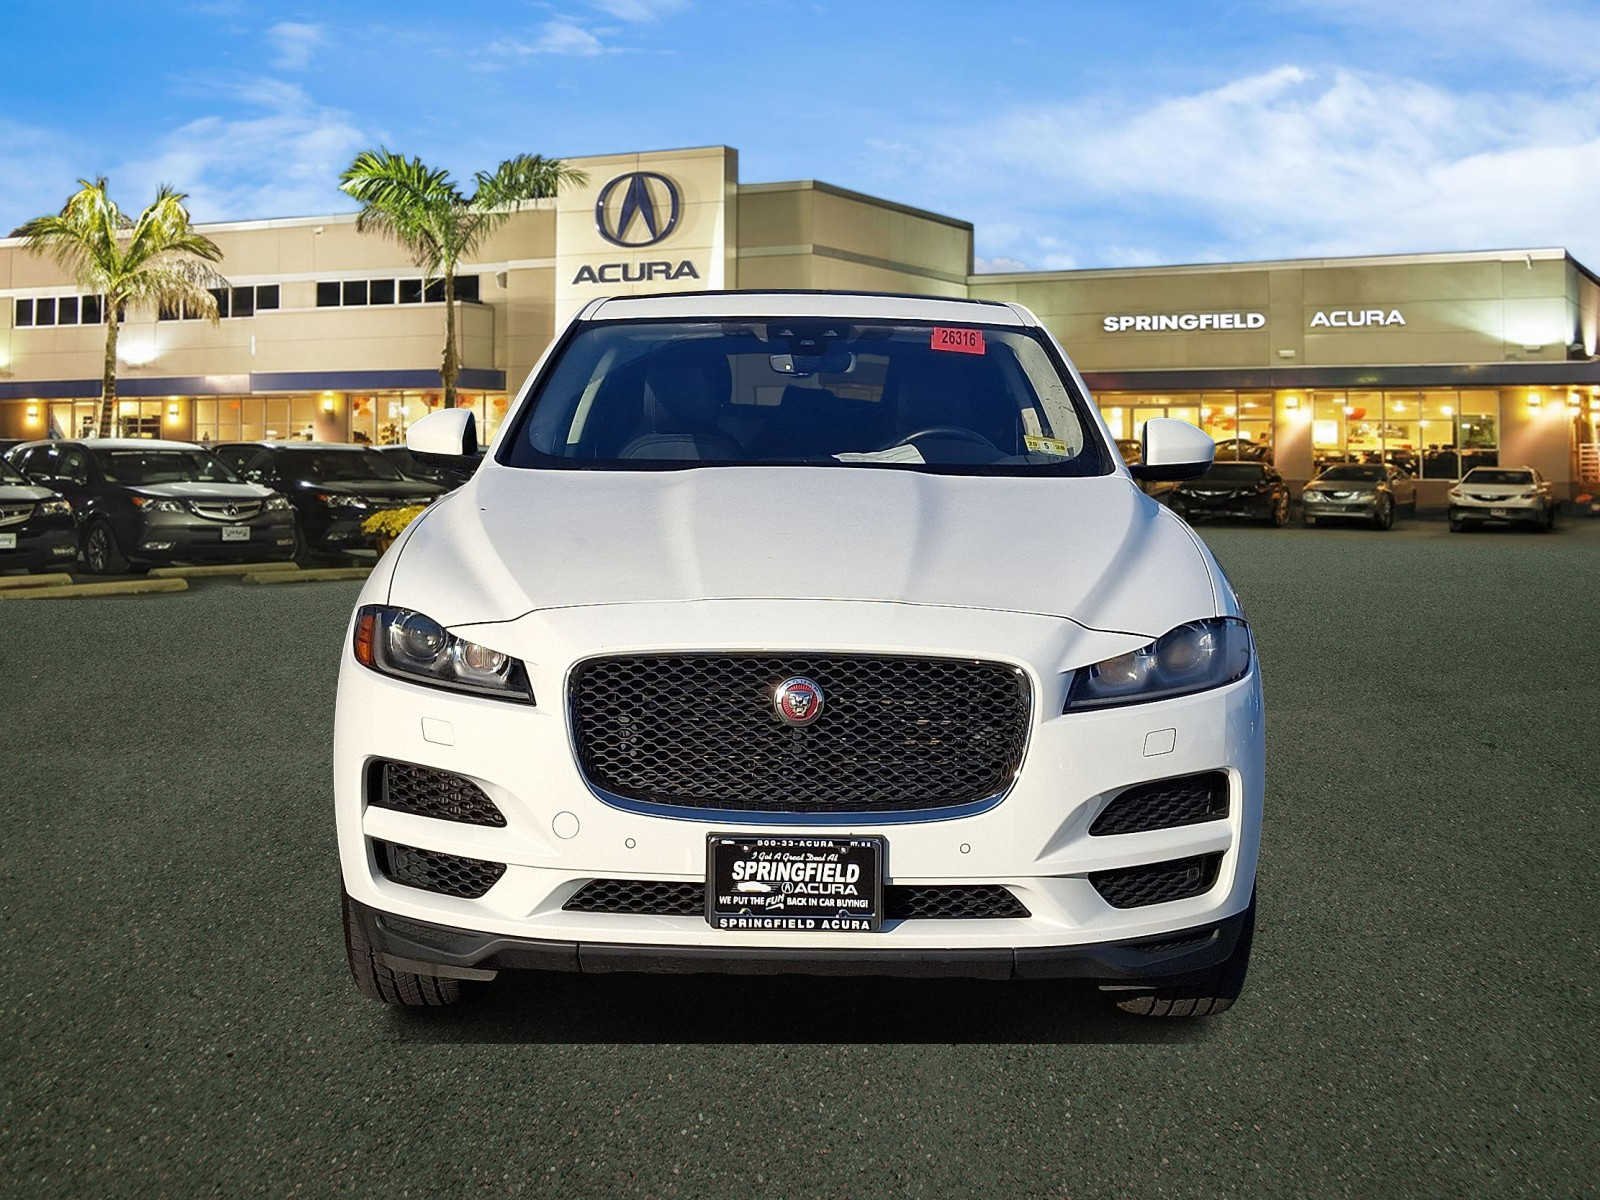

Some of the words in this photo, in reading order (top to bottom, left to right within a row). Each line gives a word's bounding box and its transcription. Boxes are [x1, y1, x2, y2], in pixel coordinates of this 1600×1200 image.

[572, 260, 700, 285] ACURA
[1103, 312, 1266, 332] SPRINGFIELD
[1310, 309, 1406, 327] ACURA
[941, 329, 976, 346] 26316
[782, 853, 804, 861] Great
[732, 861, 860, 883] SPRINGFIELD
[794, 882, 858, 895] ACURA
[719, 896, 732, 904] WE
[733, 896, 748, 905] PUT
[750, 897, 765, 905] THE
[765, 893, 785, 906] FUN
[787, 897, 807, 906] BACK
[808, 898, 817, 906] IN
[819, 898, 835, 907] CAR
[836, 899, 869, 908] BUYING!
[719, 918, 815, 929] SPRINGFIELD
[821, 919, 870, 930] ACURA
